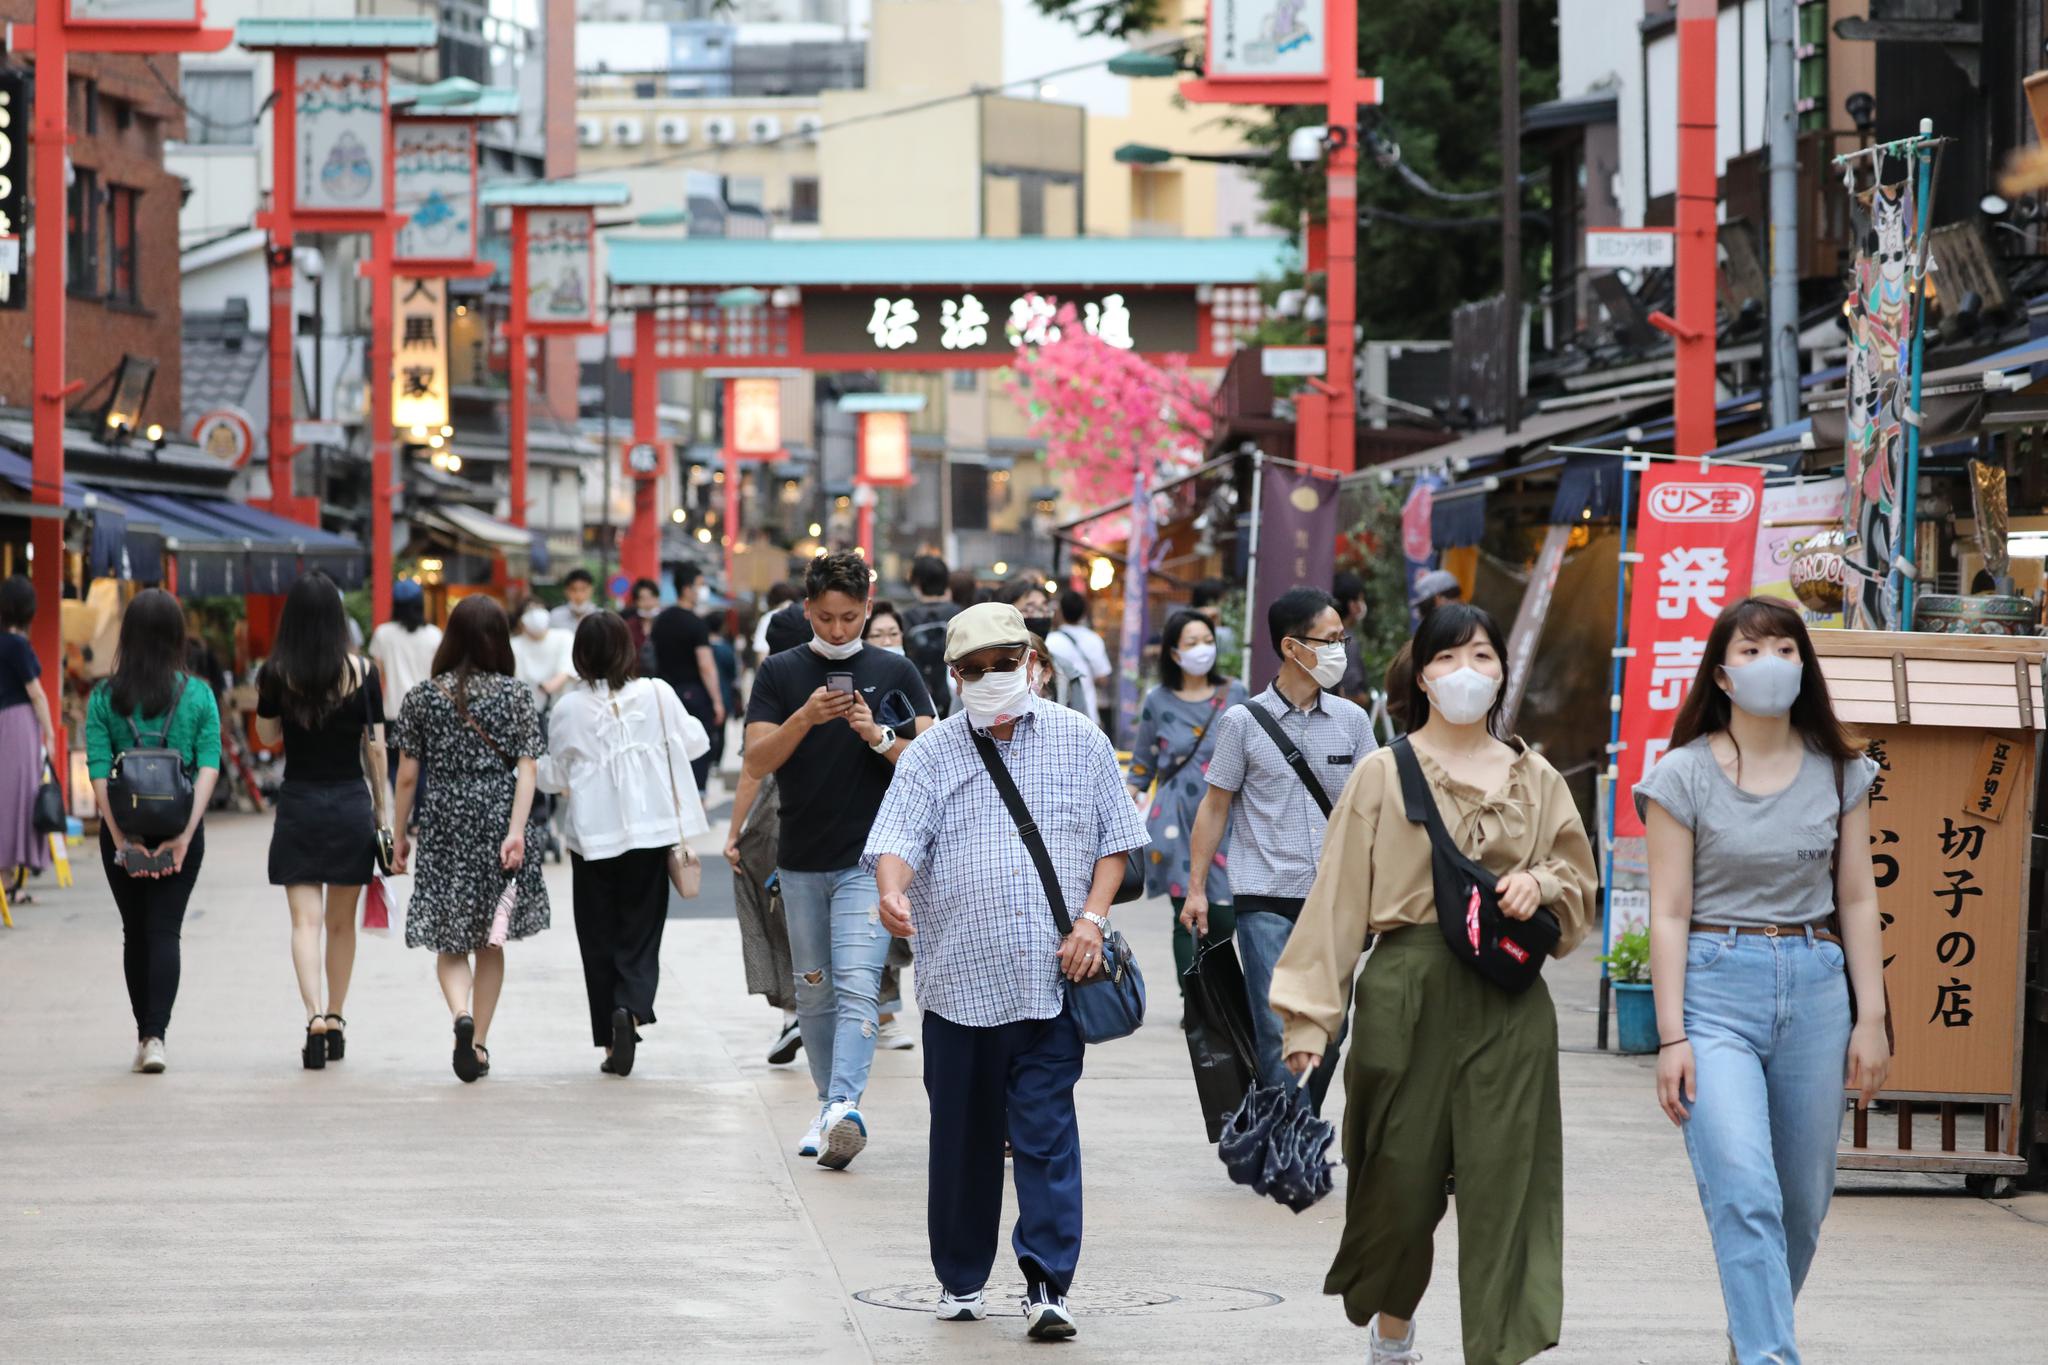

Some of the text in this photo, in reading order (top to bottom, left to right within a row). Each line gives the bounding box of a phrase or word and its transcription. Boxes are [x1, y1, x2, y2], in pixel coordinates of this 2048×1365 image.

[1977, 742, 2011, 812] 江戸切子
[1928, 818, 1986, 1027] 切子の店
